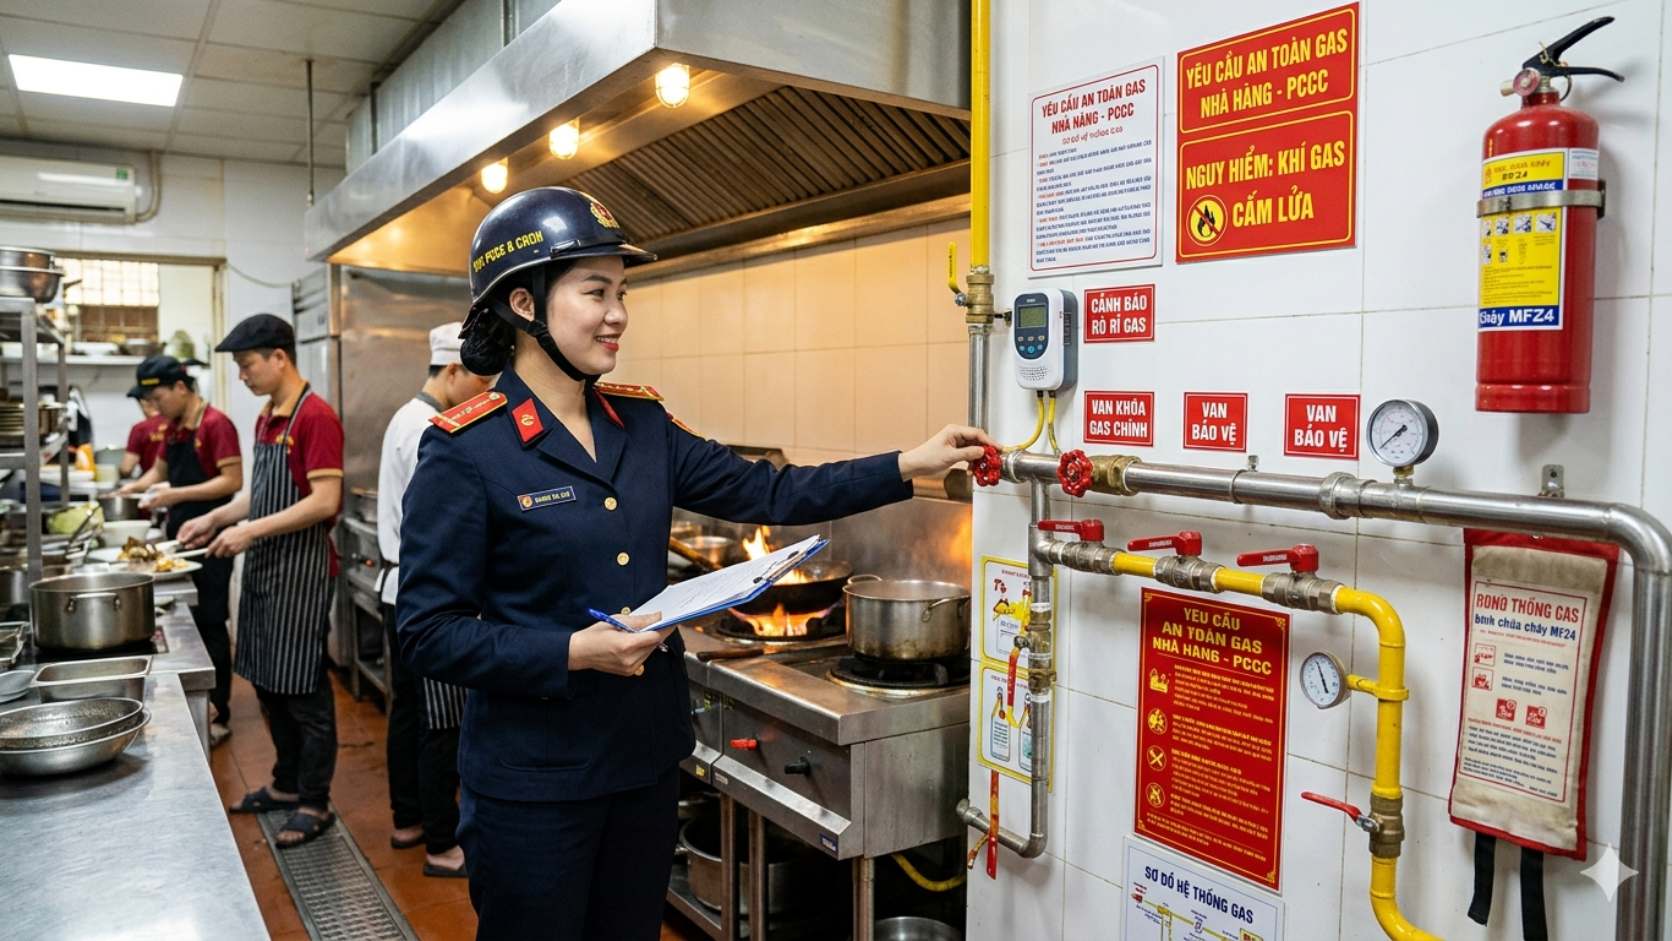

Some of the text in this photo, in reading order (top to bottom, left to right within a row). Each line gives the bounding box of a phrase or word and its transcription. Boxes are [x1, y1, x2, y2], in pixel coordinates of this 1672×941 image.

[1215, 50, 1243, 83] CẦU
[1247, 48, 1268, 75] AN
[1315, 28, 1348, 58] GAS
[1081, 92, 1094, 110] AN
[1125, 79, 1146, 97] GAS
[1287, 68, 1328, 100] PCCC
[1108, 102, 1134, 121] PCCC
[1186, 140, 1345, 190] NGUY HIỂM: KHÍ GAS
[1232, 184, 1314, 228] CẤM LỬA
[1124, 292, 1147, 311] BÁO
[1123, 317, 1146, 333] GAS
[1509, 308, 1554, 323] MFZ4
[1092, 398, 1146, 416] VAN KHÓA
[1202, 402, 1227, 418] VAN
[1306, 404, 1337, 422] VAN
[1089, 418, 1148, 438] GAS CHÍNH
[1191, 419, 1237, 446] BÁO VỆ
[1294, 423, 1348, 452] BÁO VỆ
[1161, 621, 1182, 637] AN
[1231, 635, 1262, 655] GAS
[1233, 655, 1272, 675] PCCC
[1193, 886, 1228, 914] THỐNG
[1231, 903, 1254, 924] GAS
